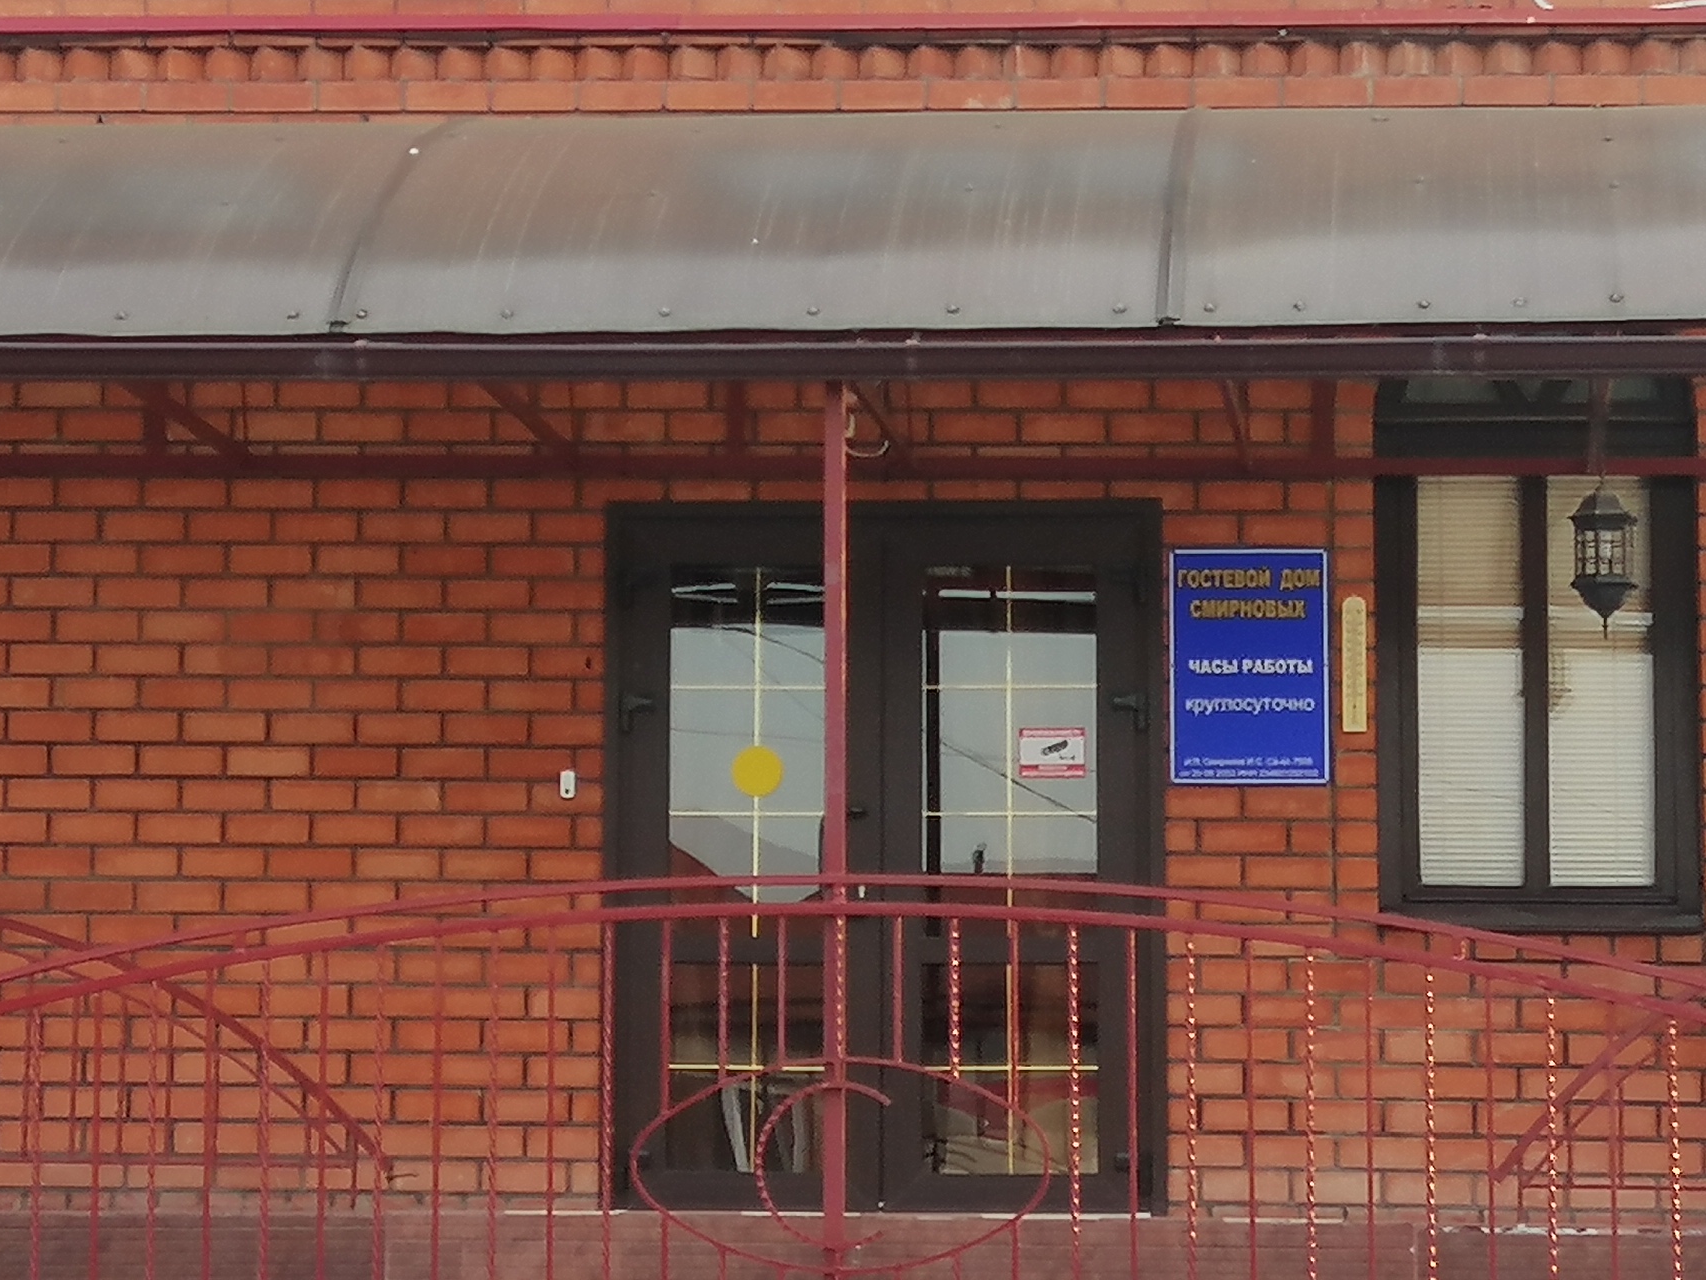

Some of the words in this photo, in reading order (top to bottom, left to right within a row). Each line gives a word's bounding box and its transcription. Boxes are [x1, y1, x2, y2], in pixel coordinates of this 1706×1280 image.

[1177, 567, 1271, 589] ГОСТЕВОЙ
[1280, 570, 1320, 591] ДОМ
[1190, 599, 1306, 619] СМИРНОВЫХ
[1188, 659, 1238, 674] ЧАСЫ
[1242, 659, 1313, 674] РАБОТЫ
[1185, 698, 1315, 715] круглосуточно
